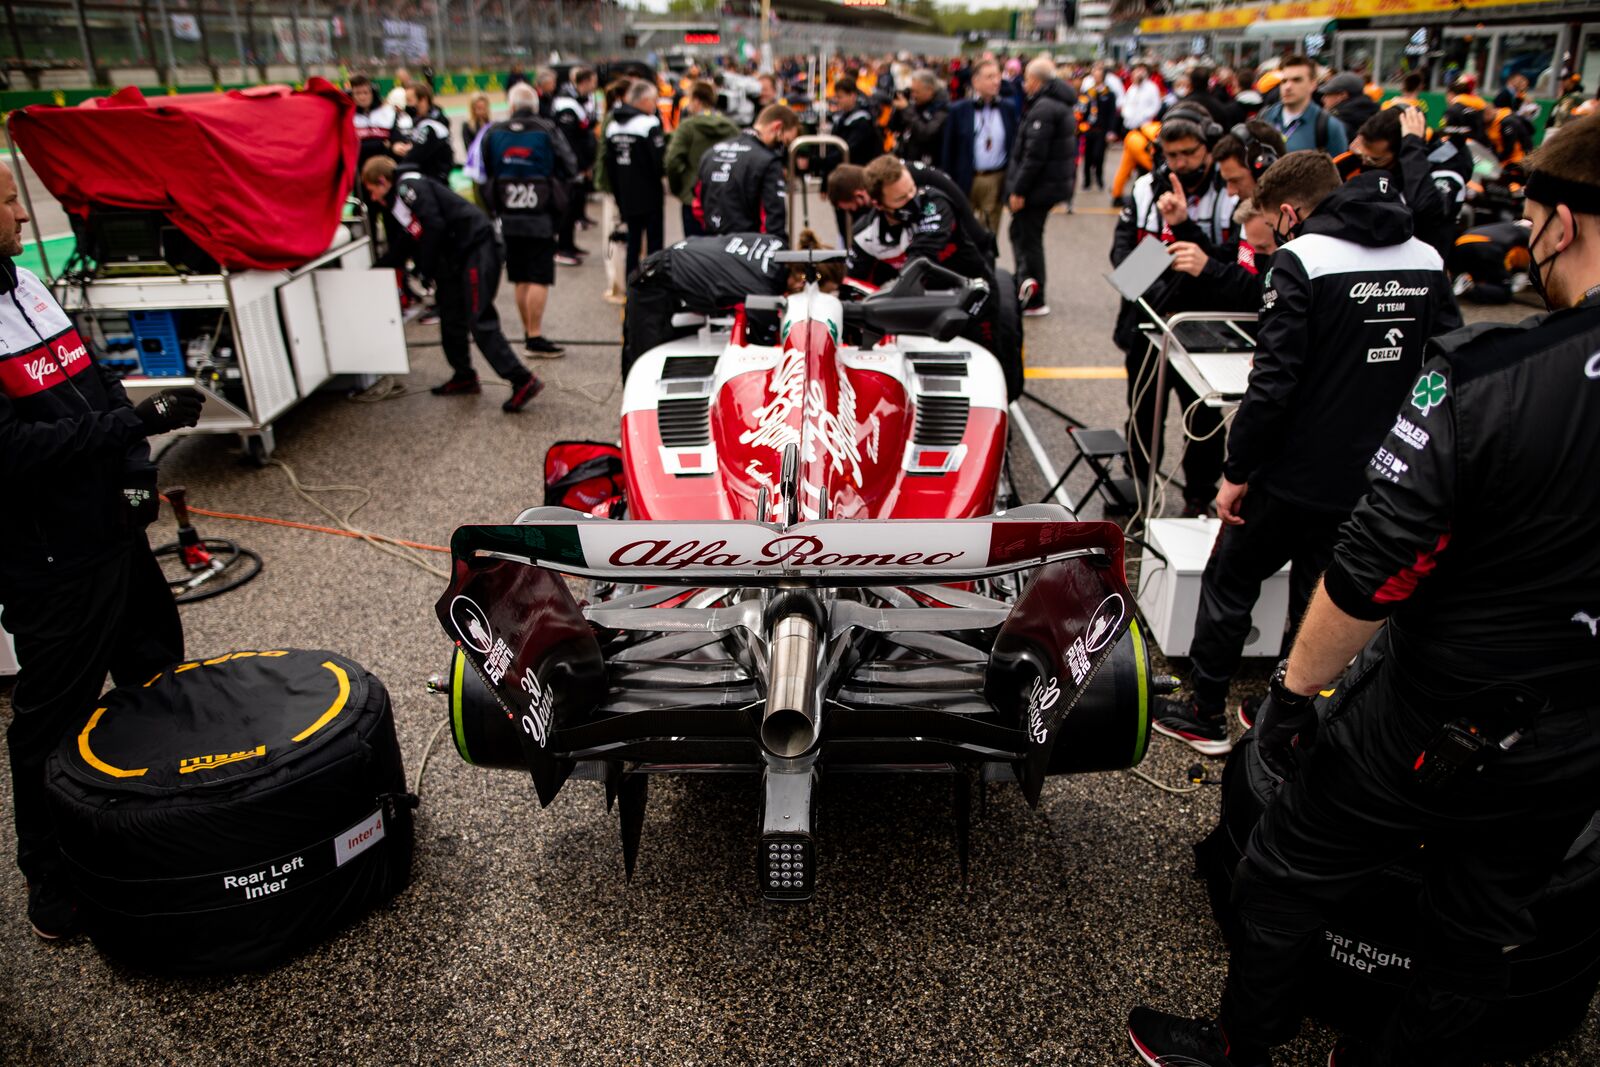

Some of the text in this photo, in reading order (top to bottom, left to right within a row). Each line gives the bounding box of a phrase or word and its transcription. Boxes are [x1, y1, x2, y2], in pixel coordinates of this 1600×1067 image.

[506, 183, 538, 208] 226
[1350, 280, 1429, 304] Alfa Romeo
[1377, 302, 1406, 312] F1 TEAM
[1370, 350, 1399, 360] ORLEN
[608, 535, 965, 570] Alfa Romeo
[520, 667, 542, 707] 30
[1039, 676, 1061, 710] 30
[347, 818, 382, 850] Inter 4
[223, 856, 305, 889] Rear Left
[245, 878, 288, 900] Inter
[1325, 930, 1412, 969] ear Right
[1330, 944, 1377, 973] Inter
